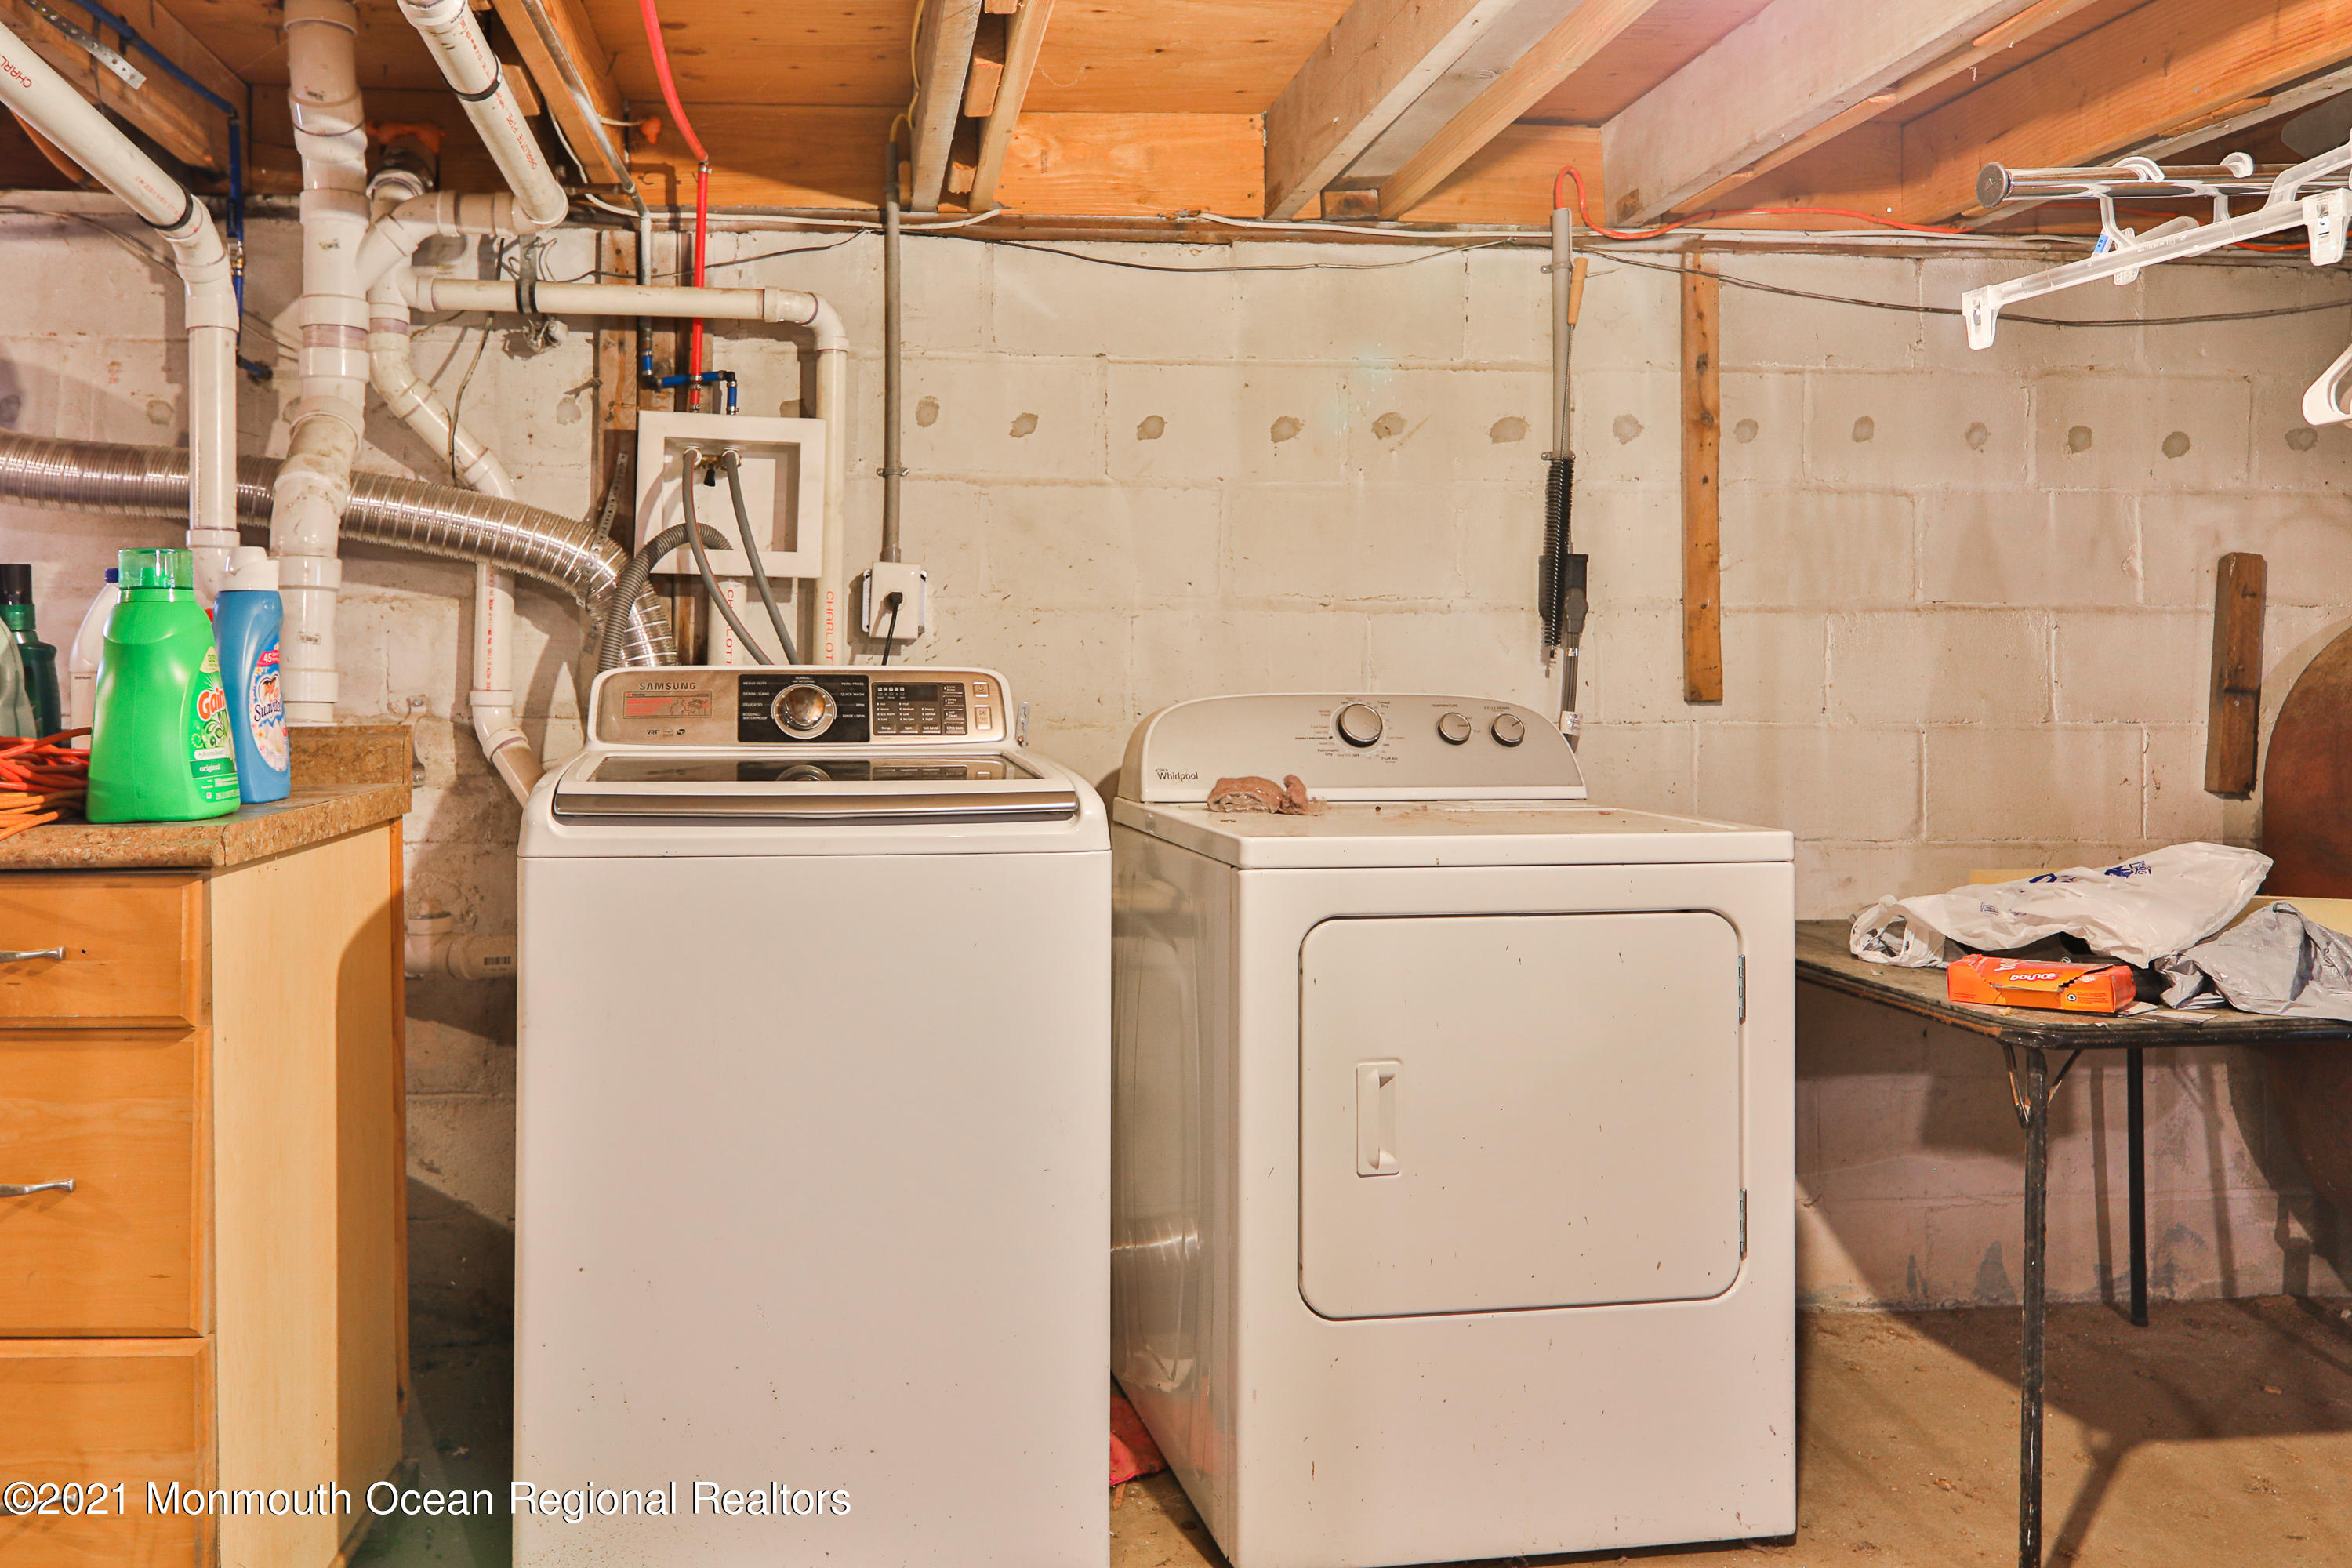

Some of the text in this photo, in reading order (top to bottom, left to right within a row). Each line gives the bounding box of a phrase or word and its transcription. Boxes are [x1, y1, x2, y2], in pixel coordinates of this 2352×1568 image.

[725, 590, 734, 665] CHLOTT
[263, 653, 272, 663] 45
[198, 687, 226, 720] Gain
[1157, 771, 1199, 782] Whirlpool
[2009, 972, 2056, 981] bounce
